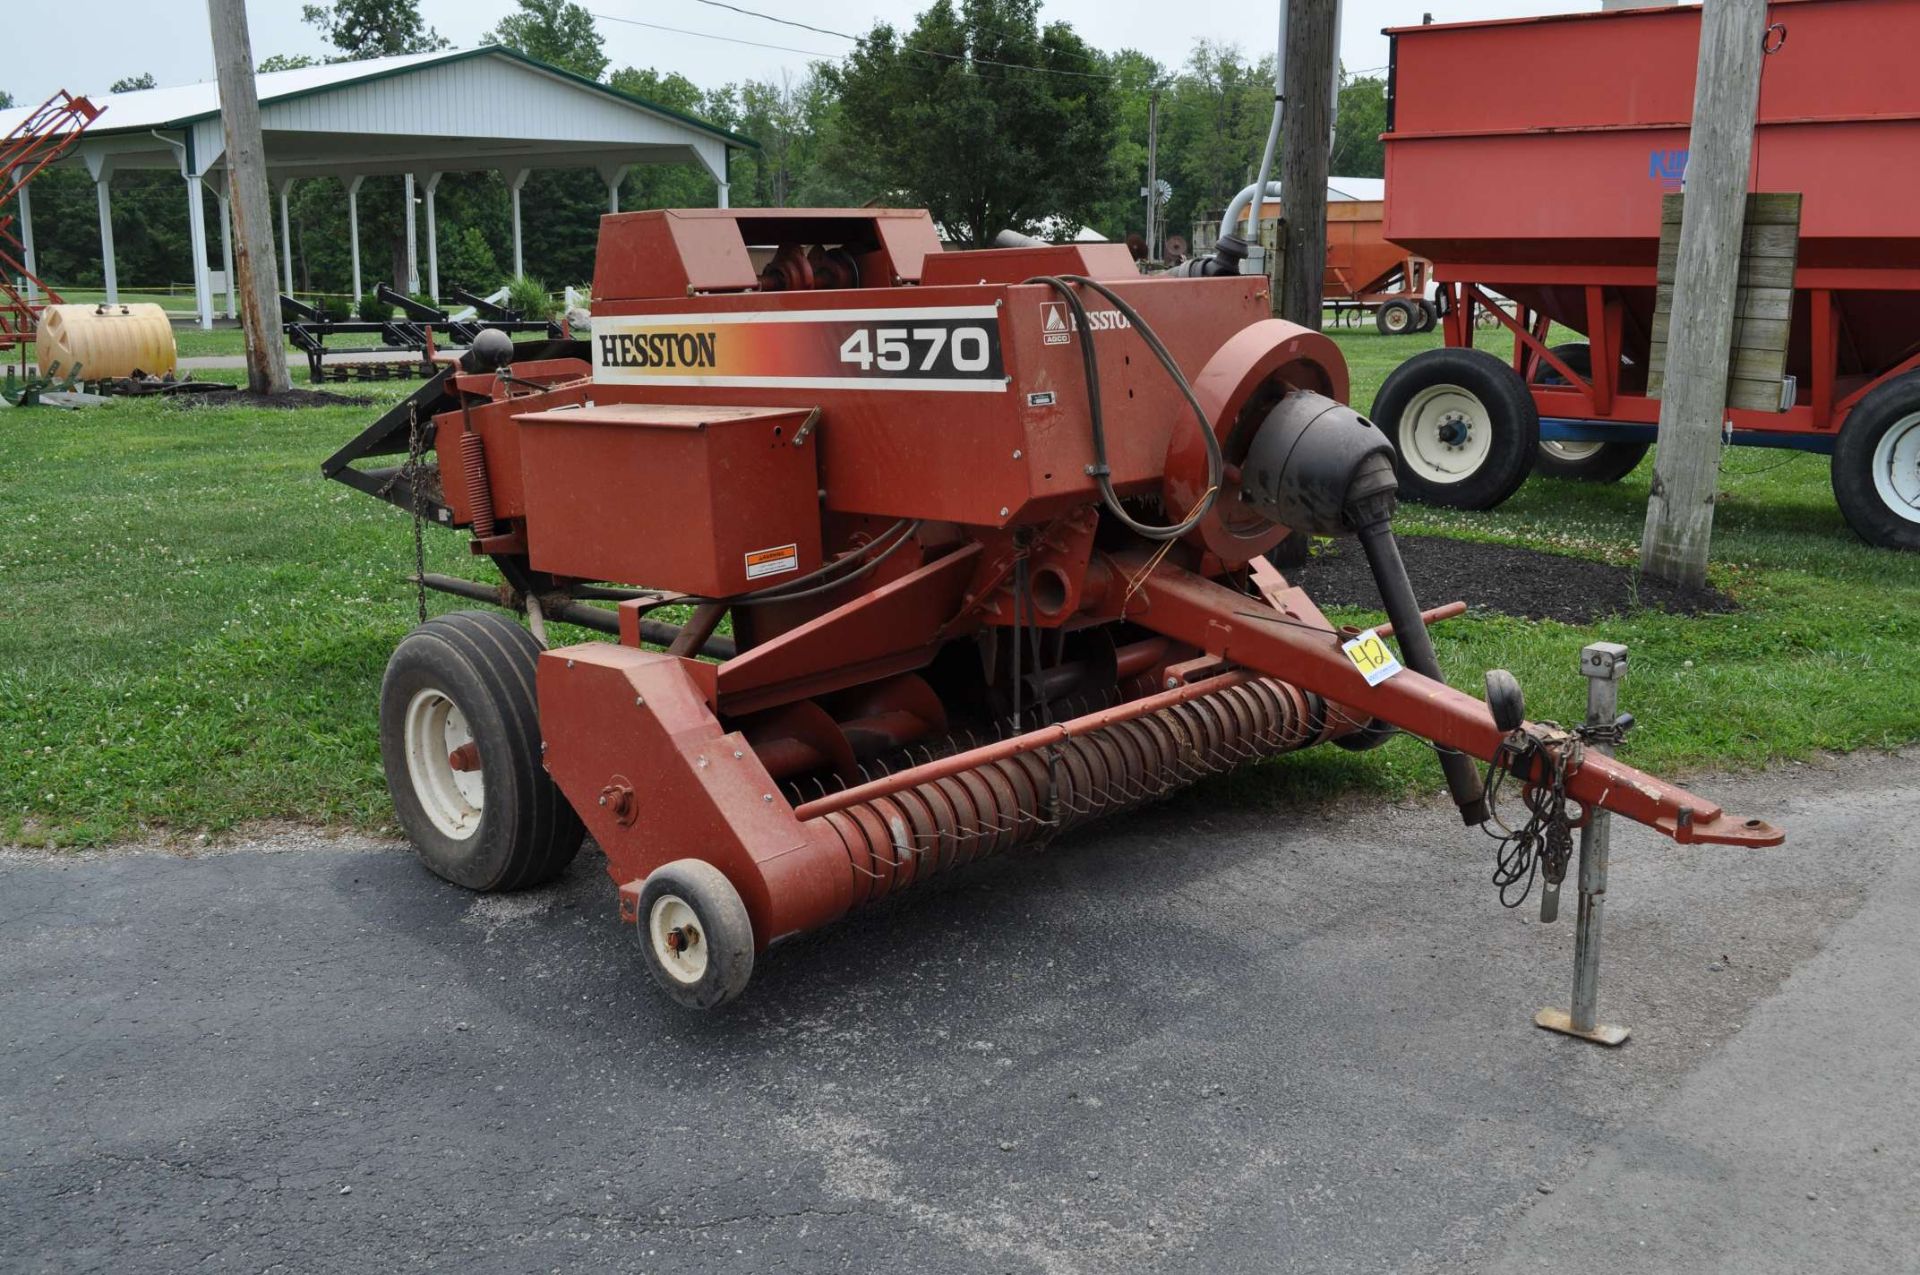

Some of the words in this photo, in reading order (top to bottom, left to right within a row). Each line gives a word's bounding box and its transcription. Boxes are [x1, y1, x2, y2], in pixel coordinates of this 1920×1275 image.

[599, 332, 716, 367] HESSTON
[840, 326, 990, 372] 4570
[1349, 638, 1385, 669] 42
